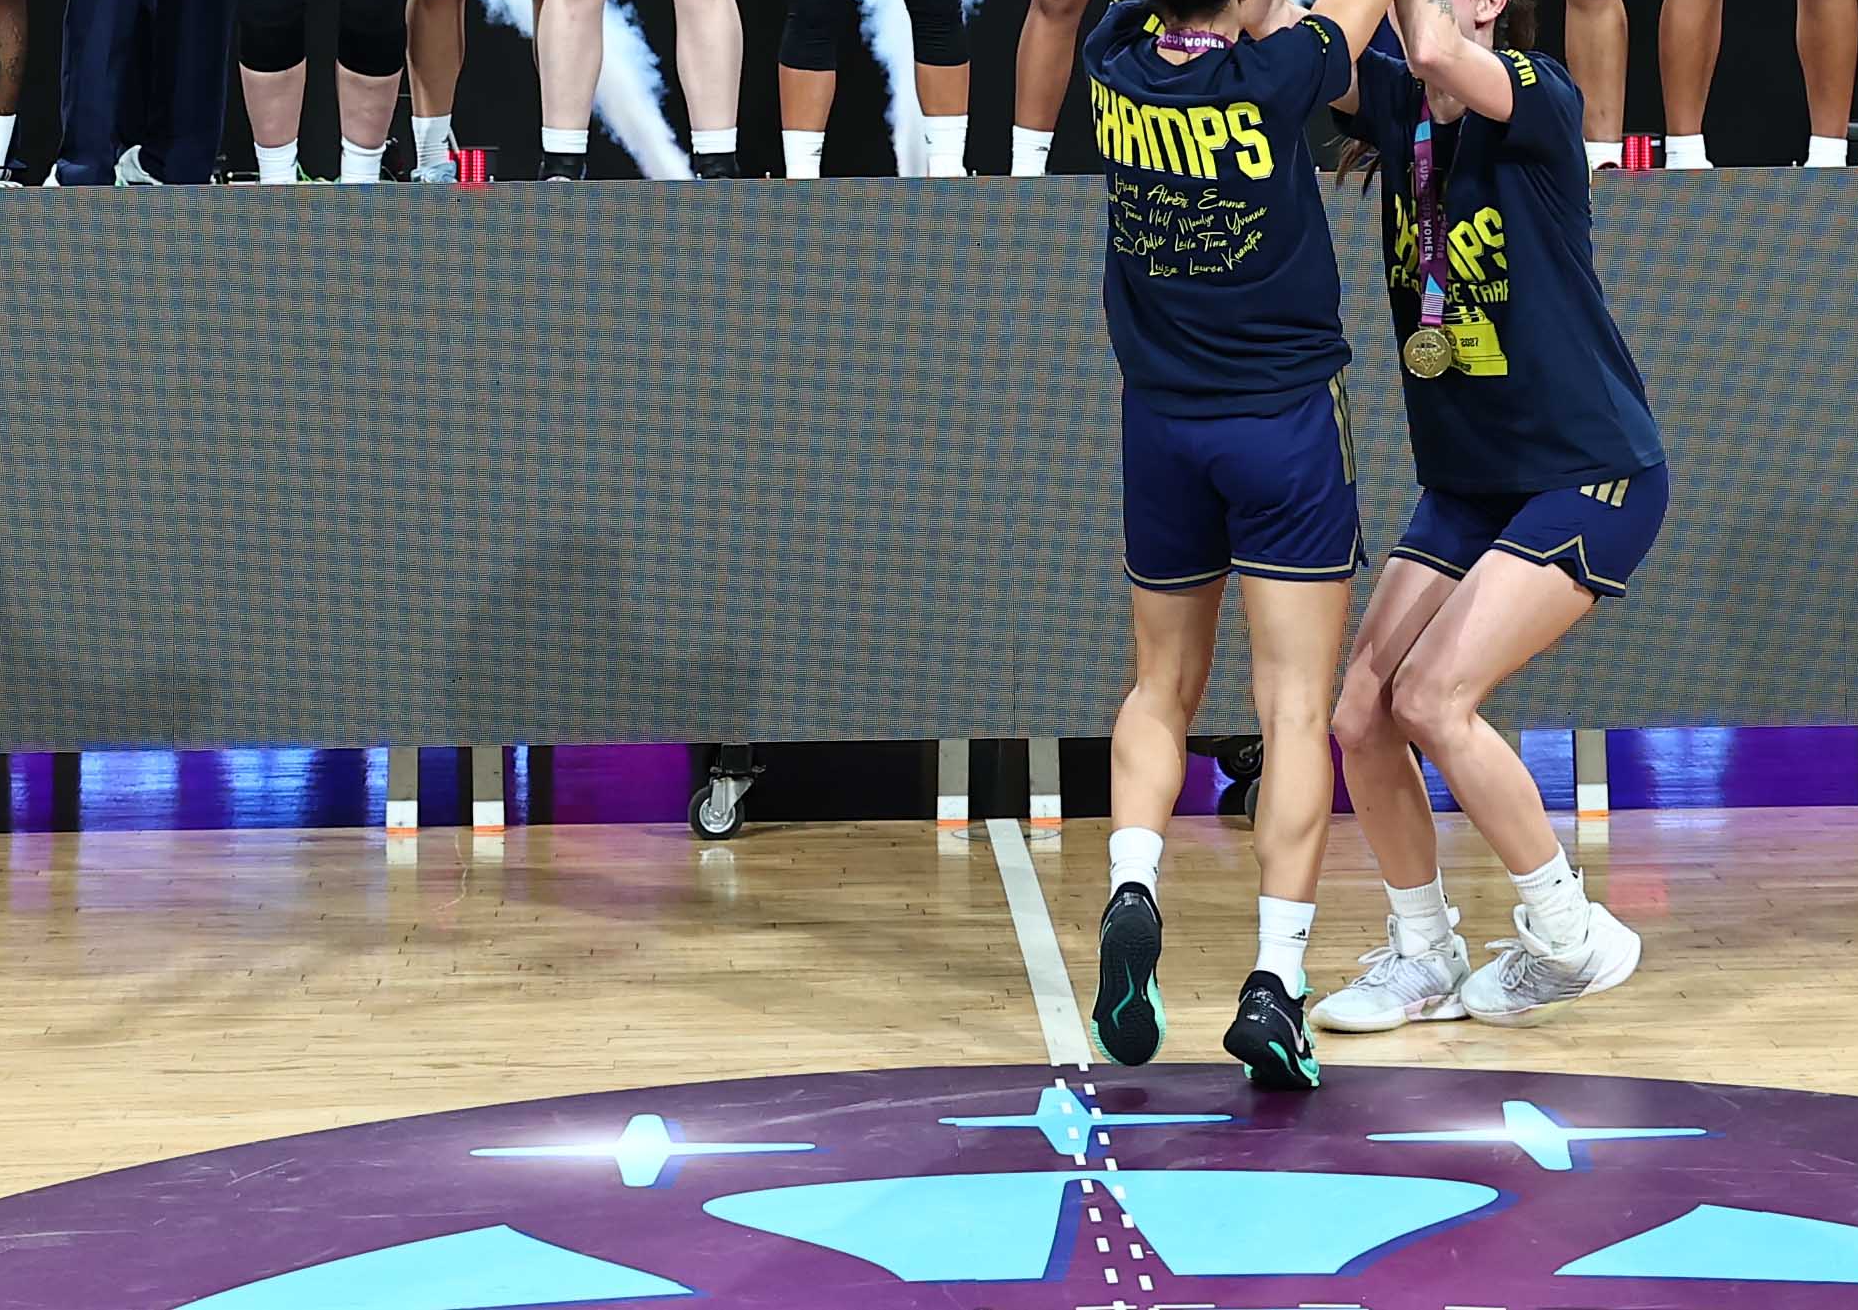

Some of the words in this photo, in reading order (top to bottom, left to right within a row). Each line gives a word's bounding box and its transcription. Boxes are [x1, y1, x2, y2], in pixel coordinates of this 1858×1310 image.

[1089, 78, 1274, 180] CHAMPS
[1198, 188, 1247, 210] Emma
[1135, 229, 1166, 256] Julie
[1460, 336, 1479, 347] 2027
